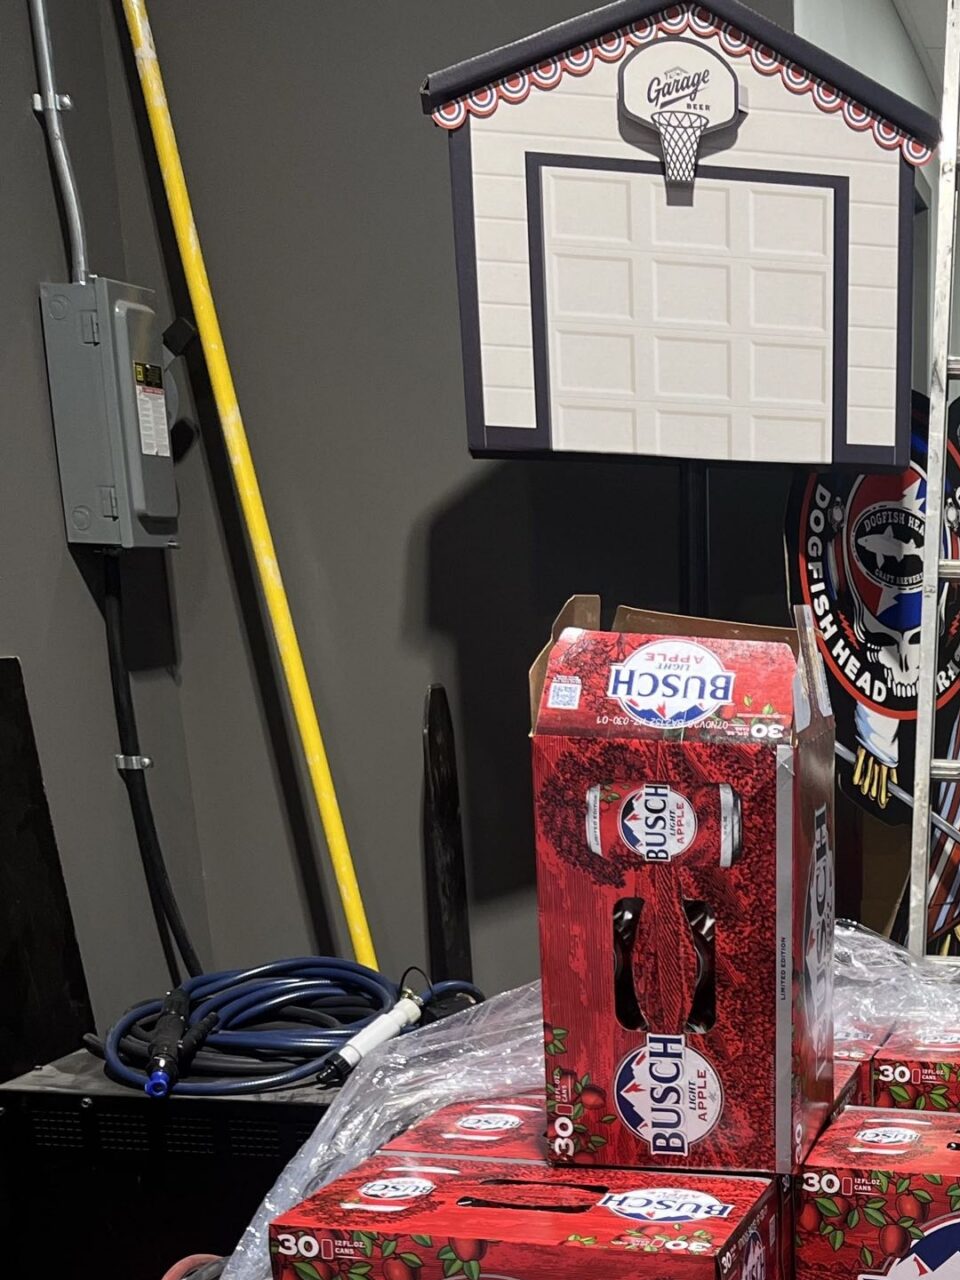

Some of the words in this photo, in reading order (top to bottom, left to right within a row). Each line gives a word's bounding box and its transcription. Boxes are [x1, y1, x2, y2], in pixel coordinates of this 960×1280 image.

[647, 69, 710, 107] Garage
[687, 103, 711, 111] BEER
[864, 511, 905, 532] DOGFISH
[908, 516, 925, 536] HEA
[807, 483, 838, 640] DOGFISH
[831, 640, 887, 703] HEAD
[645, 651, 705, 664] APPLE
[655, 662, 690, 672] LIGHT
[611, 668, 733, 702] BUSCH
[751, 723, 784, 739] 30
[645, 785, 669, 861] BUSCH
[668, 810, 677, 836] LIGHT
[676, 802, 686, 844] APPLE
[879, 1065, 911, 1083] 30
[648, 1035, 686, 1155] BUSCH
[688, 1080, 697, 1111] LIGHT
[697, 1069, 708, 1122] APPLE
[554, 1116, 575, 1158] 30
[801, 1173, 841, 1194] 30
[854, 1184, 872, 1192] CANS
[602, 1194, 733, 1218] BUSCH
[277, 1233, 319, 1258] 30
[335, 1247, 355, 1255] CANS
[721, 1251, 732, 1274] 30
